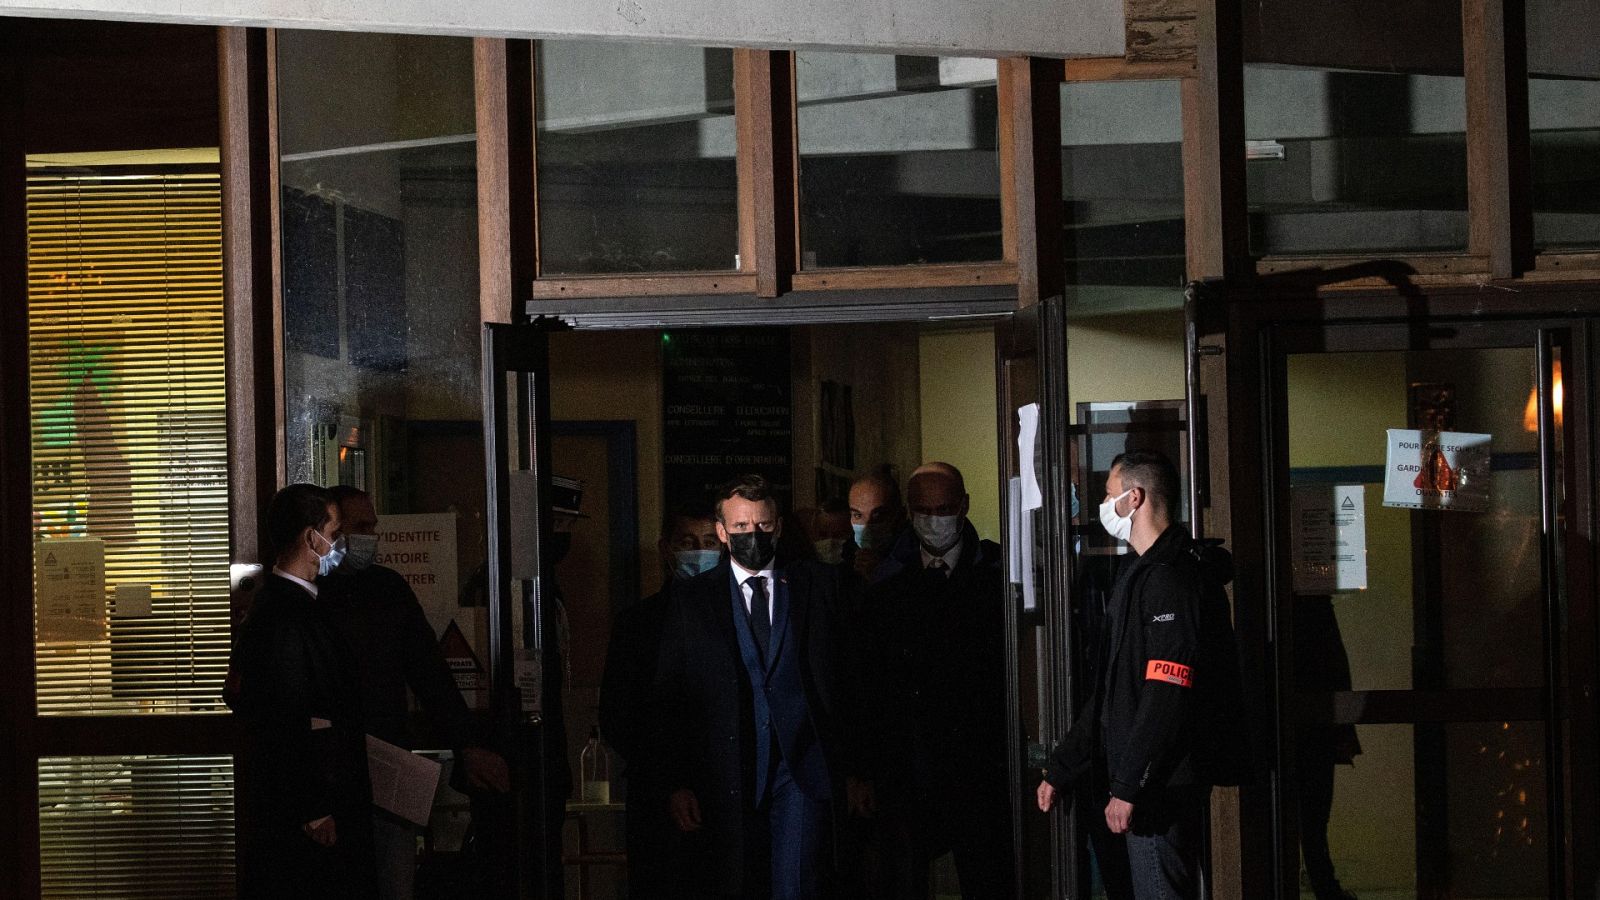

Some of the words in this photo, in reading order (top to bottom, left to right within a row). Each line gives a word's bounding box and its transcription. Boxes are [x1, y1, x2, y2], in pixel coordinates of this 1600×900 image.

[1398, 442, 1420, 450] POUR
[1397, 464, 1423, 472] GARD
[374, 552, 431, 564] GATOIRE
[403, 573, 436, 585] TRER
[1153, 662, 1193, 681] POLICE
